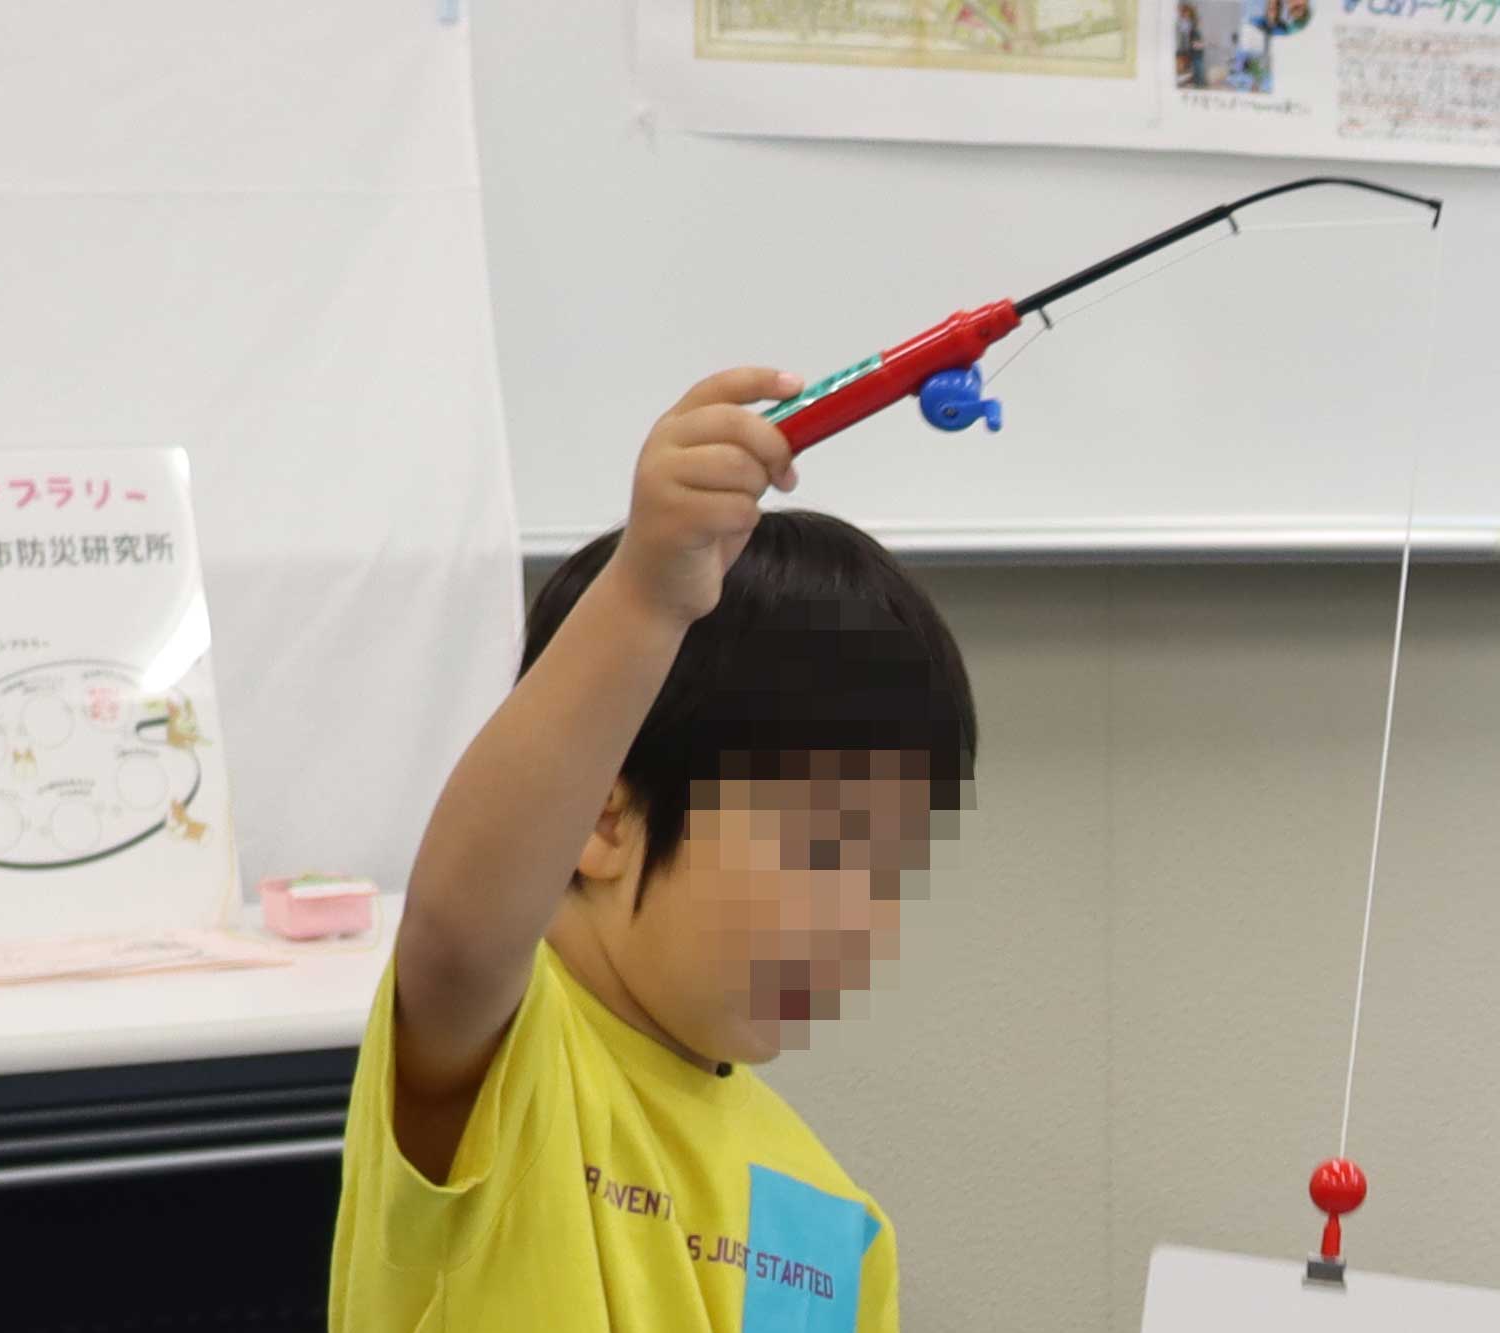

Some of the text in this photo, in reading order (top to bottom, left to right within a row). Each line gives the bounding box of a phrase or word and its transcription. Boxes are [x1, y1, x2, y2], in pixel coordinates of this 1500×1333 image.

[603, 1179, 674, 1221] AVENT
[707, 1237, 750, 1272] JUST
[755, 1252, 834, 1300] STARTED
